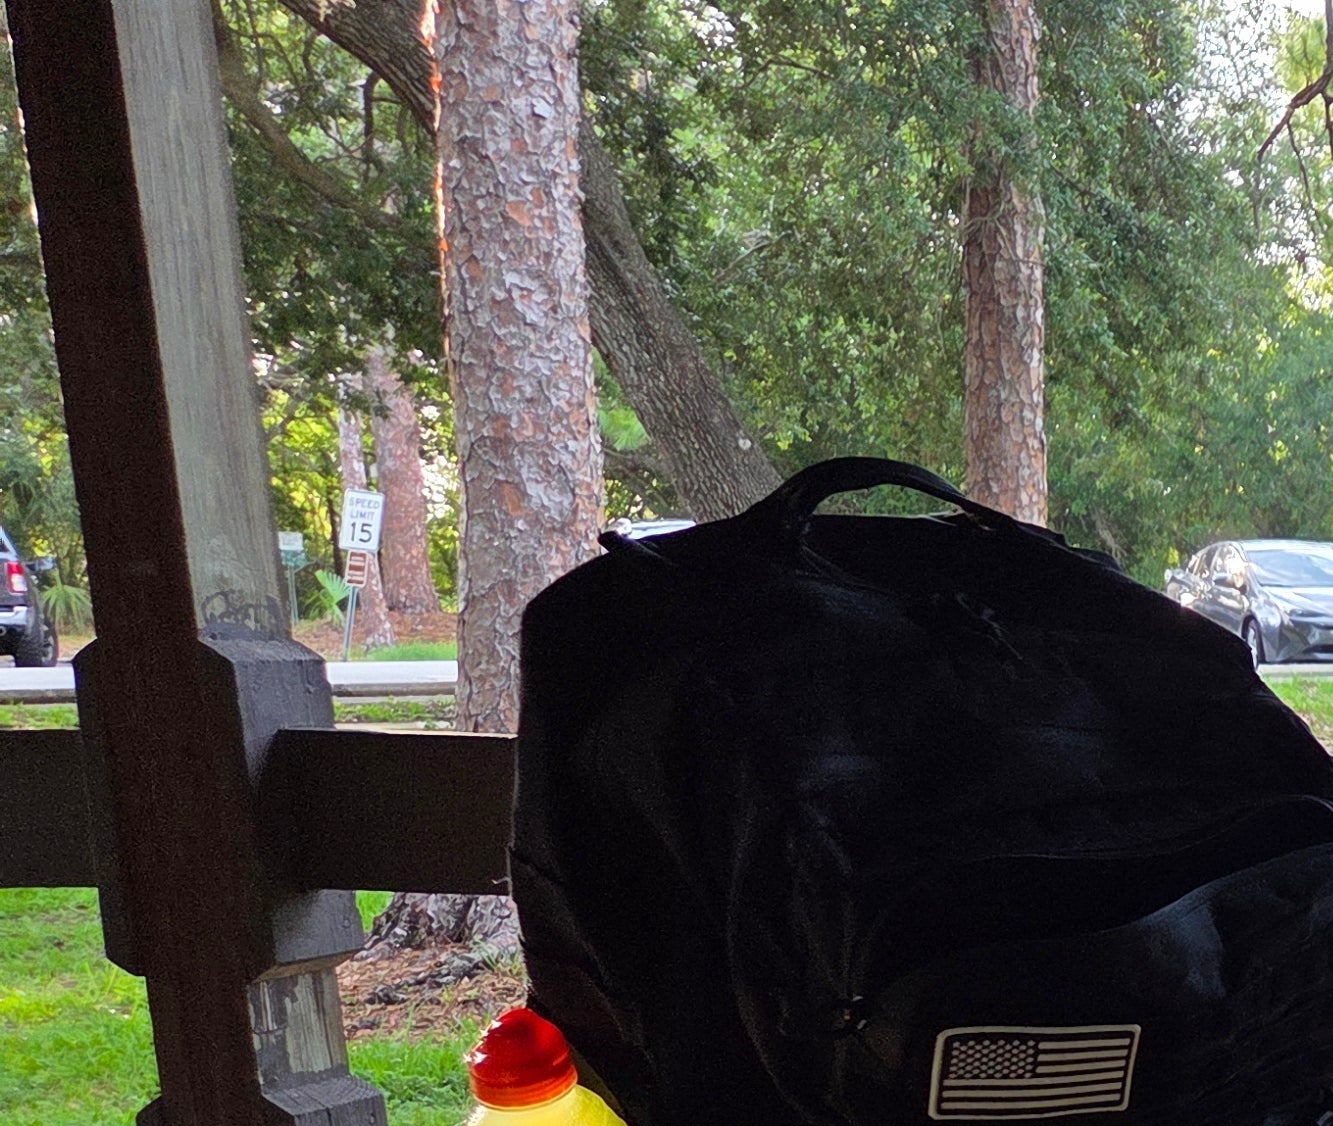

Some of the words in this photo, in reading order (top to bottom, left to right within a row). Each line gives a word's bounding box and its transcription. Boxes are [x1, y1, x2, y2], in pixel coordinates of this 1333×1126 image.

[349, 497, 380, 509] SPEED
[350, 510, 375, 521] LIMIT
[351, 521, 373, 543] 15
